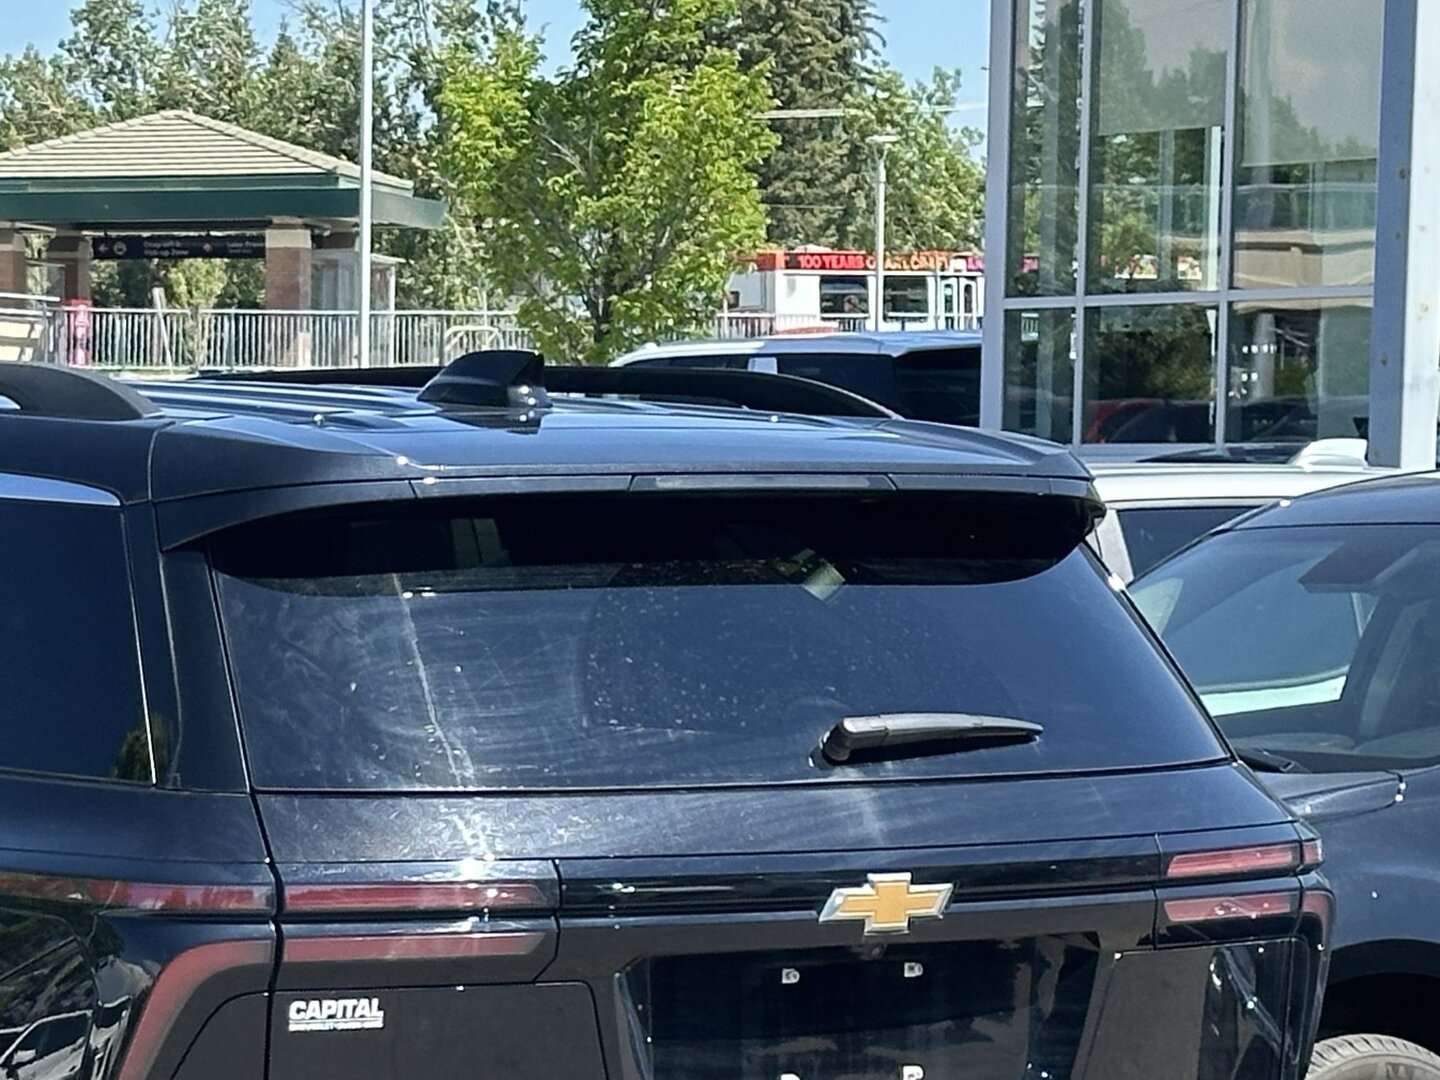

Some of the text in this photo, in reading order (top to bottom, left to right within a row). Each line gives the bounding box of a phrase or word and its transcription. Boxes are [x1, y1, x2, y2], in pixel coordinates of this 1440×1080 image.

[798, 255, 822, 269] 100
[822, 254, 865, 269] YEARS
[289, 997, 385, 1020] CAPITAL
